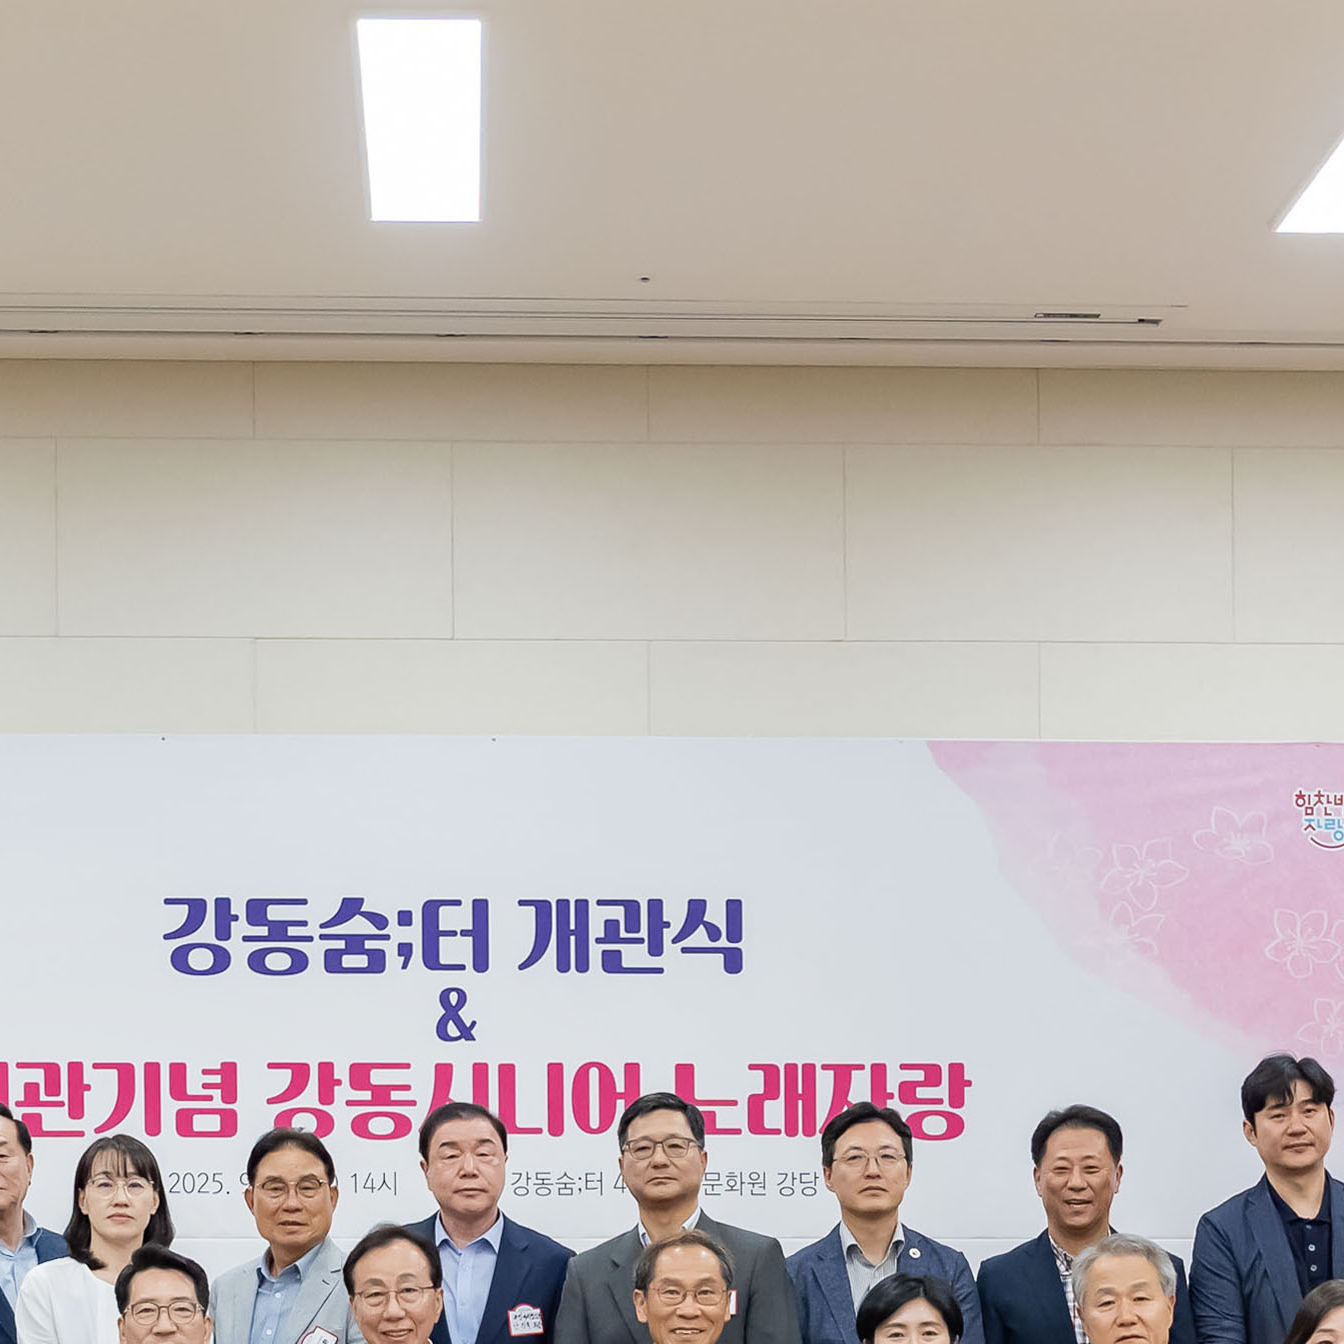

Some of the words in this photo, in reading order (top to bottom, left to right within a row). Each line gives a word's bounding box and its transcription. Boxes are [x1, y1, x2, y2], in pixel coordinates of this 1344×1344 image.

[163, 897, 490, 976] 강동숨;터
[518, 898, 744, 975] 개관식
[435, 987, 477, 1042] &
[168, 1172, 231, 1195] 2025.
[350, 1171, 398, 1196] 14시
[510, 1170, 605, 1197] 강동숨;터
[776, 1170, 820, 1197] 강당
